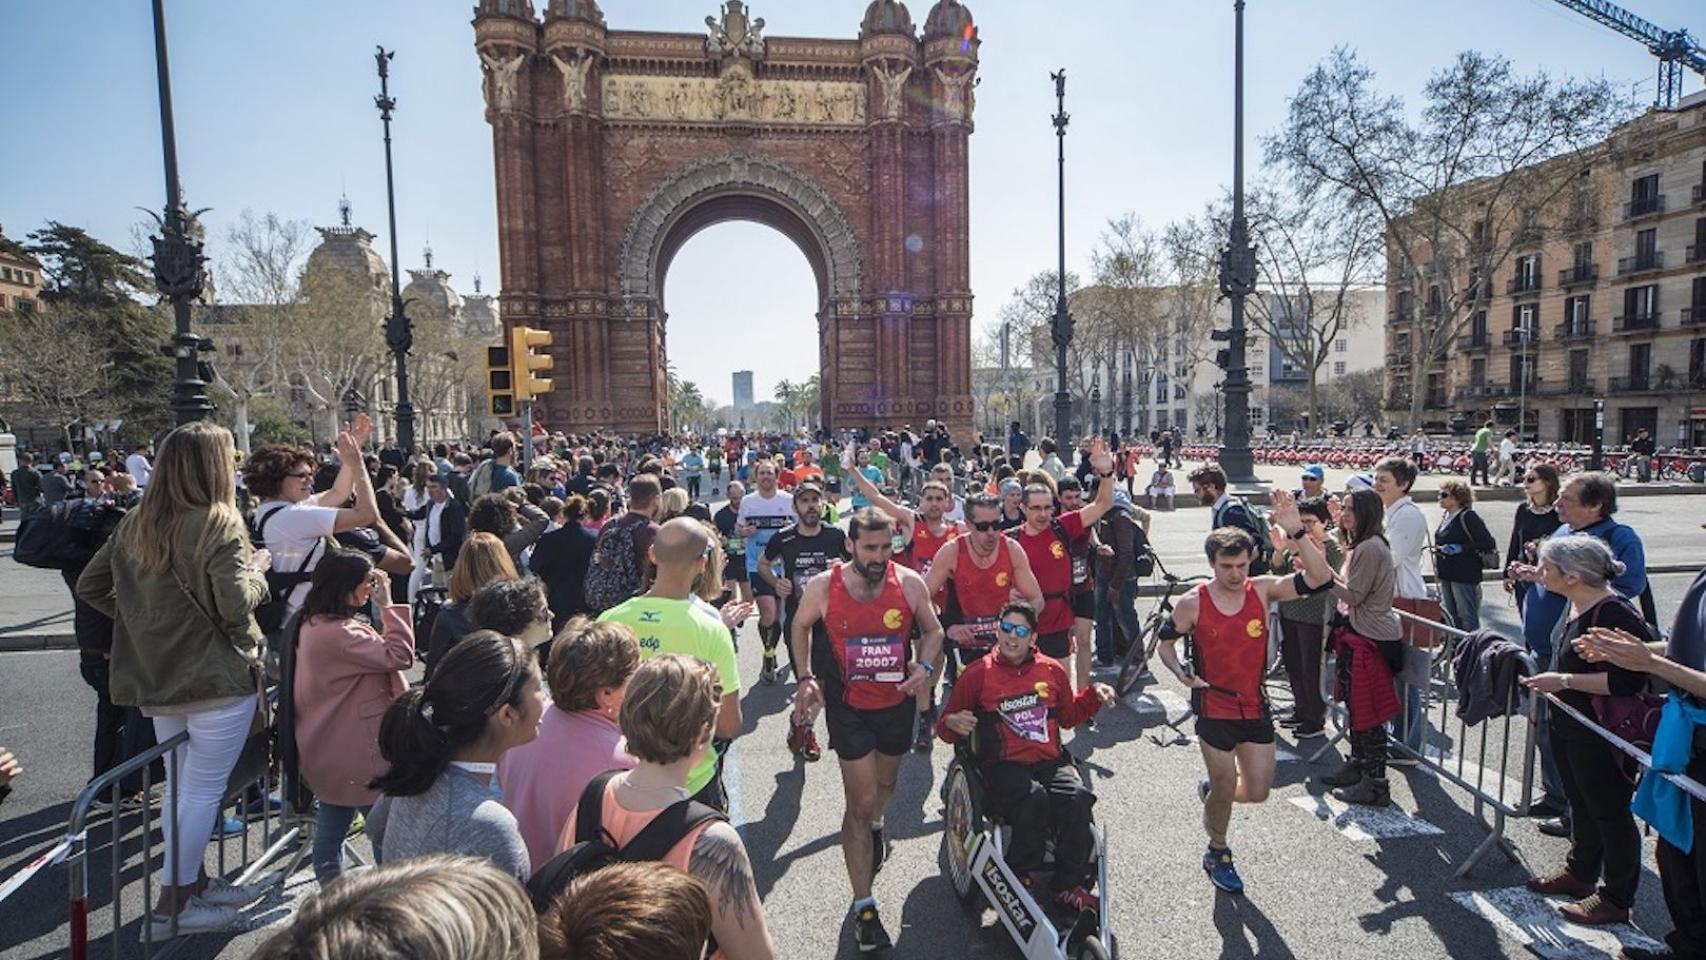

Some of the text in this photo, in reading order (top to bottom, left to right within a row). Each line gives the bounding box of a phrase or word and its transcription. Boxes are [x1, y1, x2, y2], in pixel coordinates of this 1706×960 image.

[861, 645, 891, 656] FRAN
[856, 656, 898, 669] 20007
[1014, 710, 1035, 722] POL
